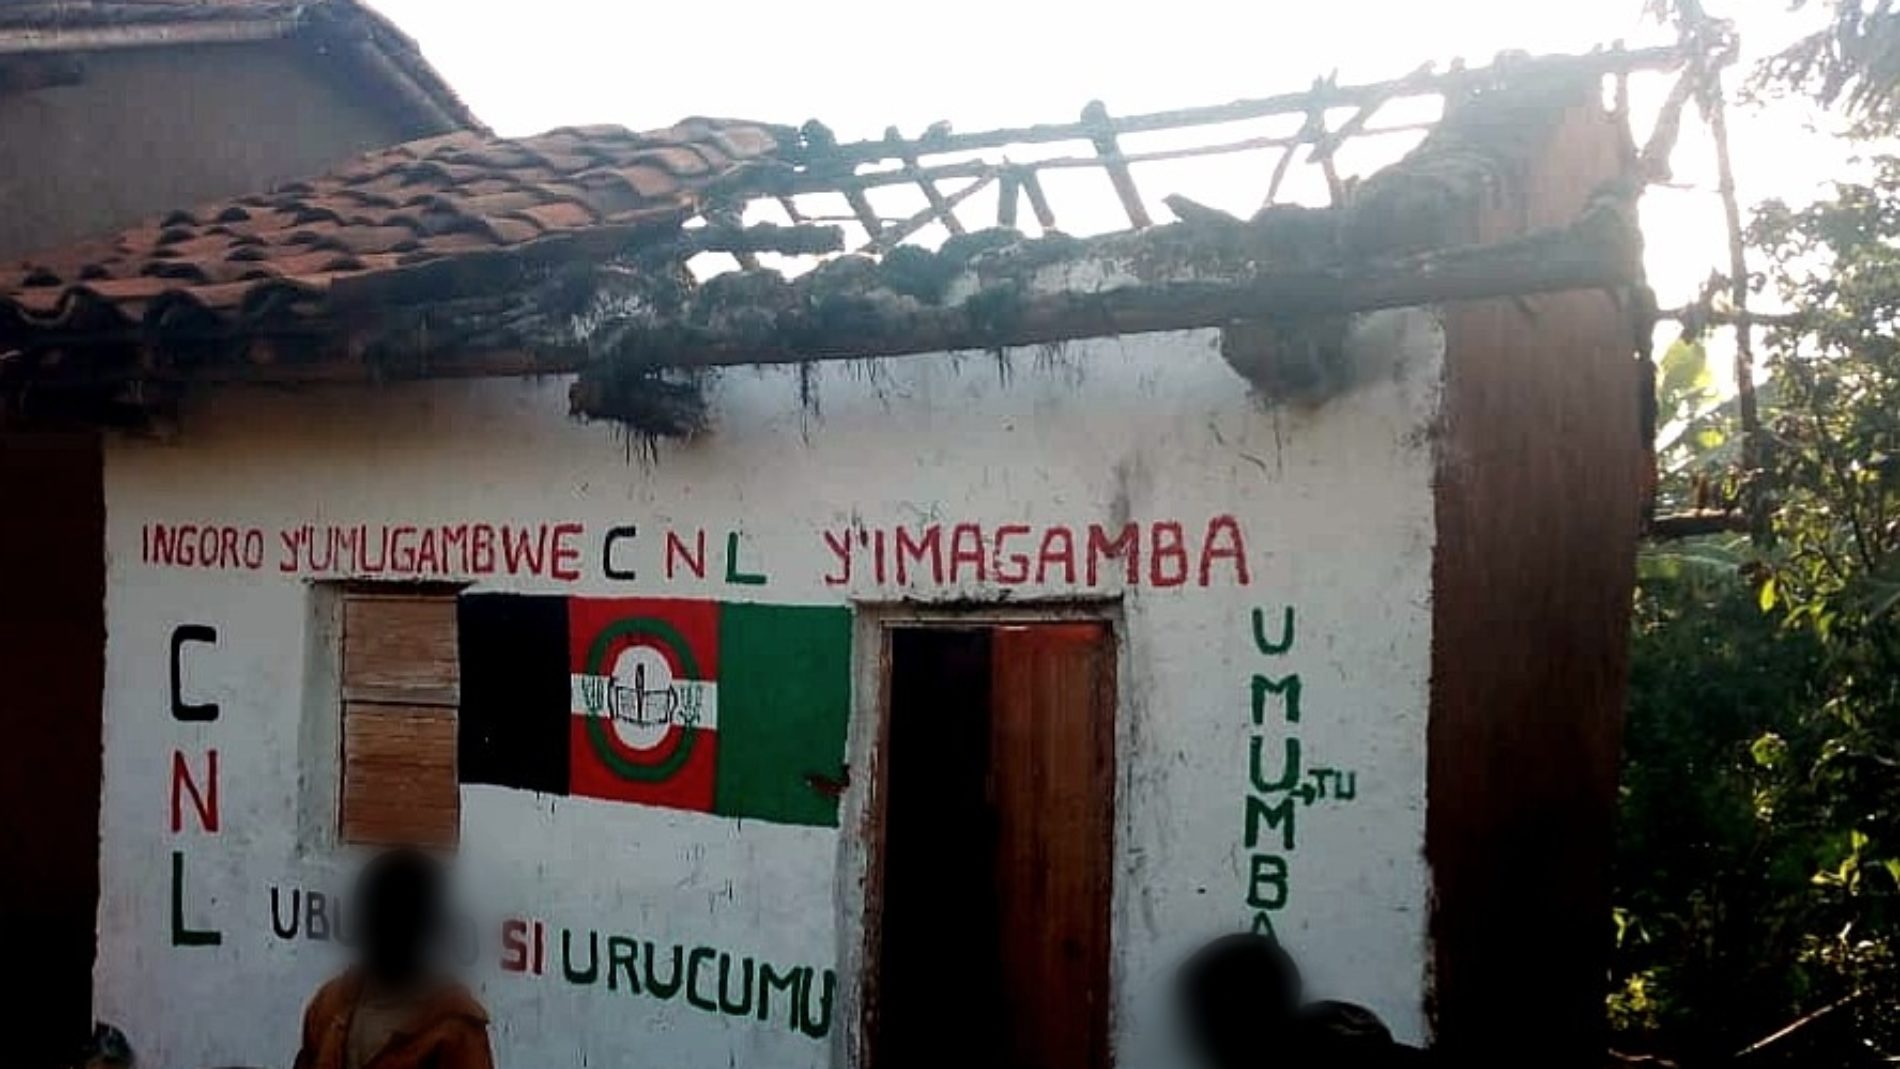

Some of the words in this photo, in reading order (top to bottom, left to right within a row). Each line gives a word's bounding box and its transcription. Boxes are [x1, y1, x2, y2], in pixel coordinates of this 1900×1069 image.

[143, 524, 264, 569] INGORO
[501, 918, 544, 976] SI
[562, 928, 838, 1039] URUCUMU
